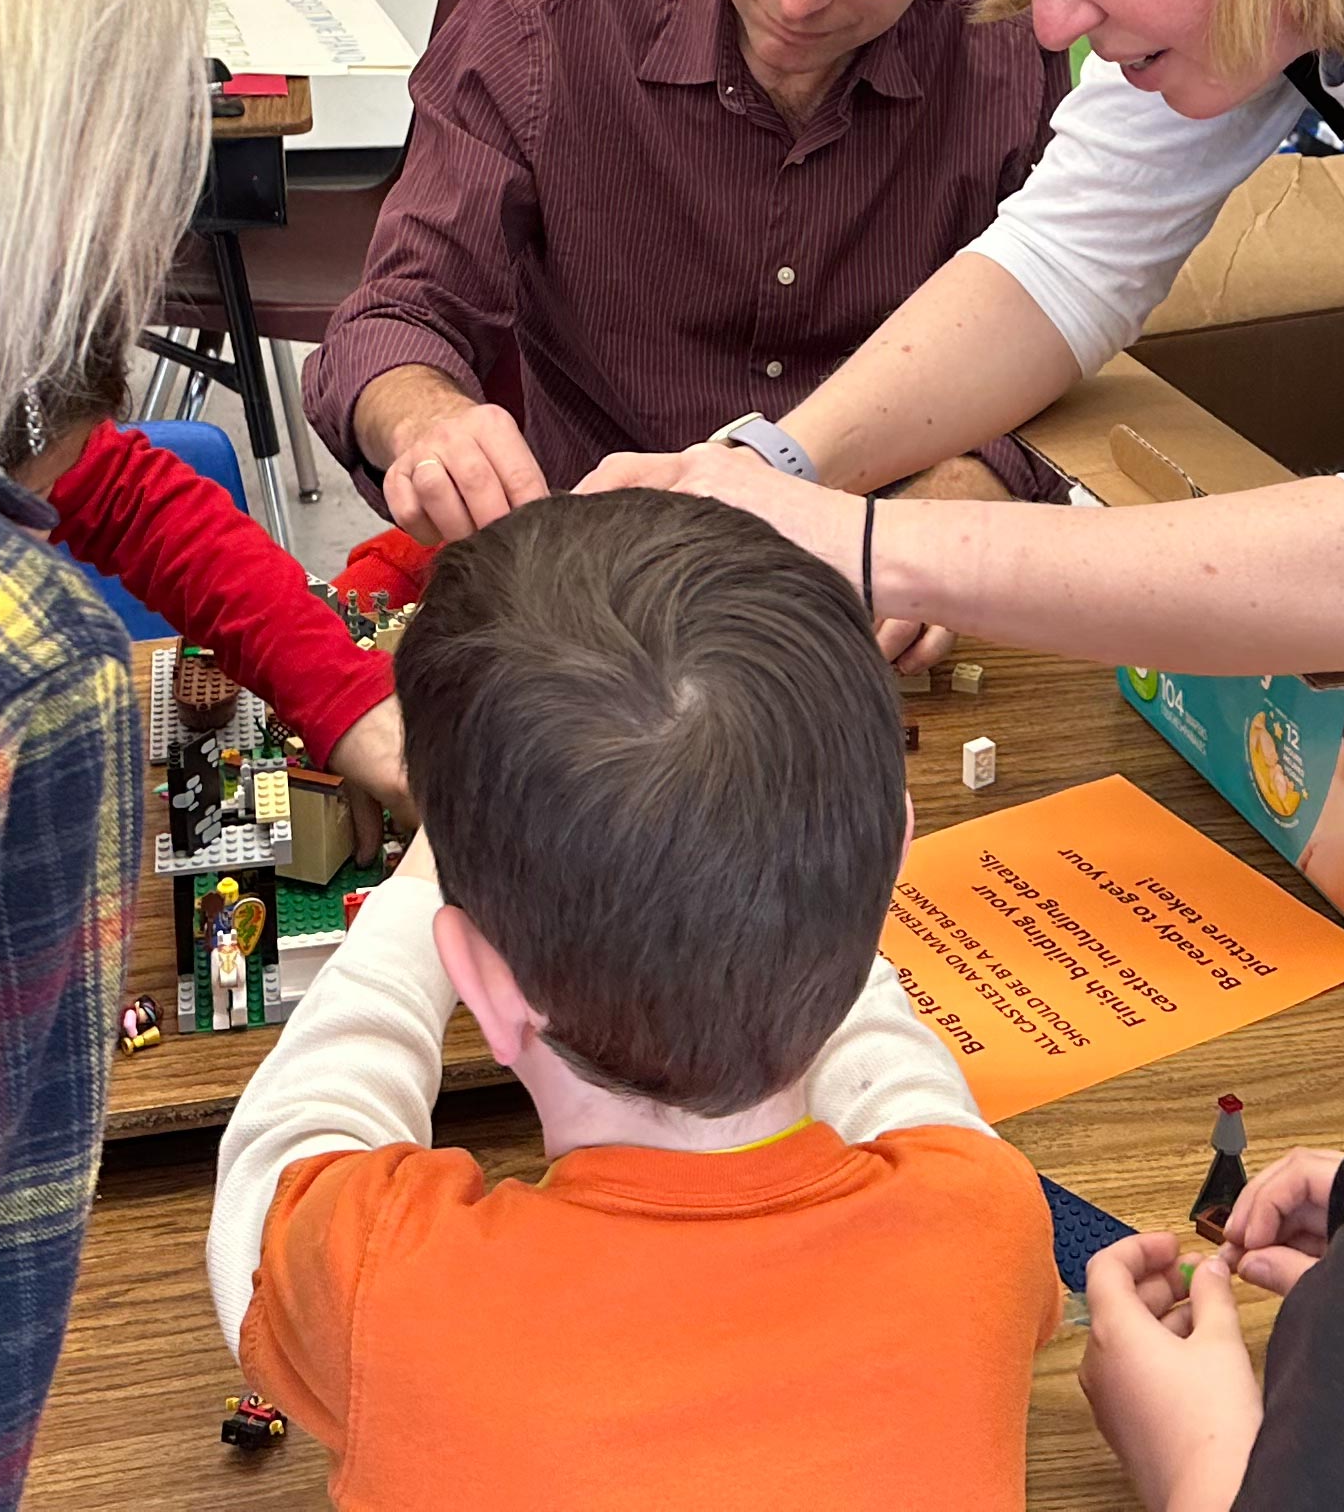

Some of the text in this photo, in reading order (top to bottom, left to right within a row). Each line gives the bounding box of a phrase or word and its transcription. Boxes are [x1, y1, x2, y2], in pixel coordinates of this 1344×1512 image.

[1160, 673, 1185, 716] 104
[1284, 723, 1301, 751] 12
[979, 849, 1178, 1013] castle including details.
[1057, 849, 1243, 991] Be ready to get your
[1135, 876, 1279, 977] picture taken!
[894, 882, 1090, 1048] SHOULD BE BY A BIG BLANKET
[945, 954, 983, 982] AND
[972, 885, 1146, 1027] Finish building your
[937, 1013, 986, 1055] Burg
[975, 982, 1037, 1034] CASTLES
[1034, 1032, 1067, 1056] ALL
